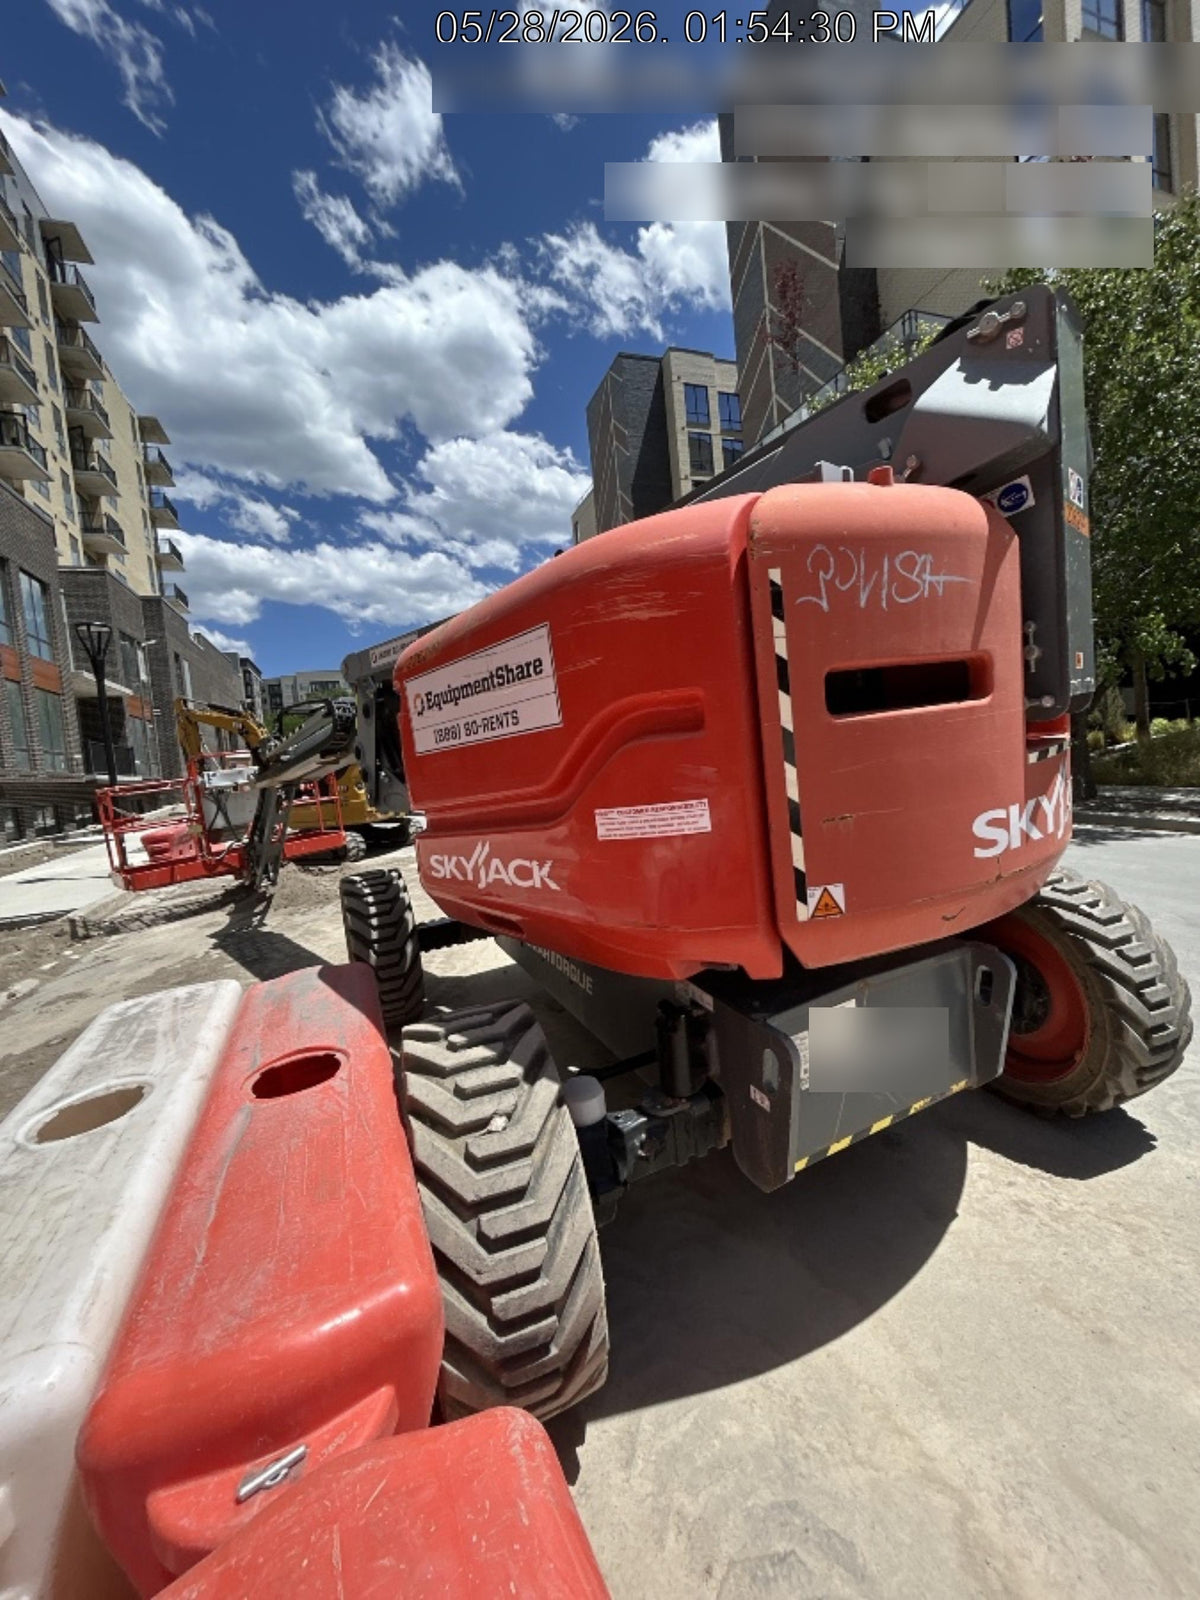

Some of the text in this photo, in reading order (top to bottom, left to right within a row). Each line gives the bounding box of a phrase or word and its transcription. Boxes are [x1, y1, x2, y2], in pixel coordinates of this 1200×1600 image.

[424, 657, 543, 711] EquipmentShare
[433, 723, 461, 744] (888)
[430, 840, 560, 891] SKYJACK
